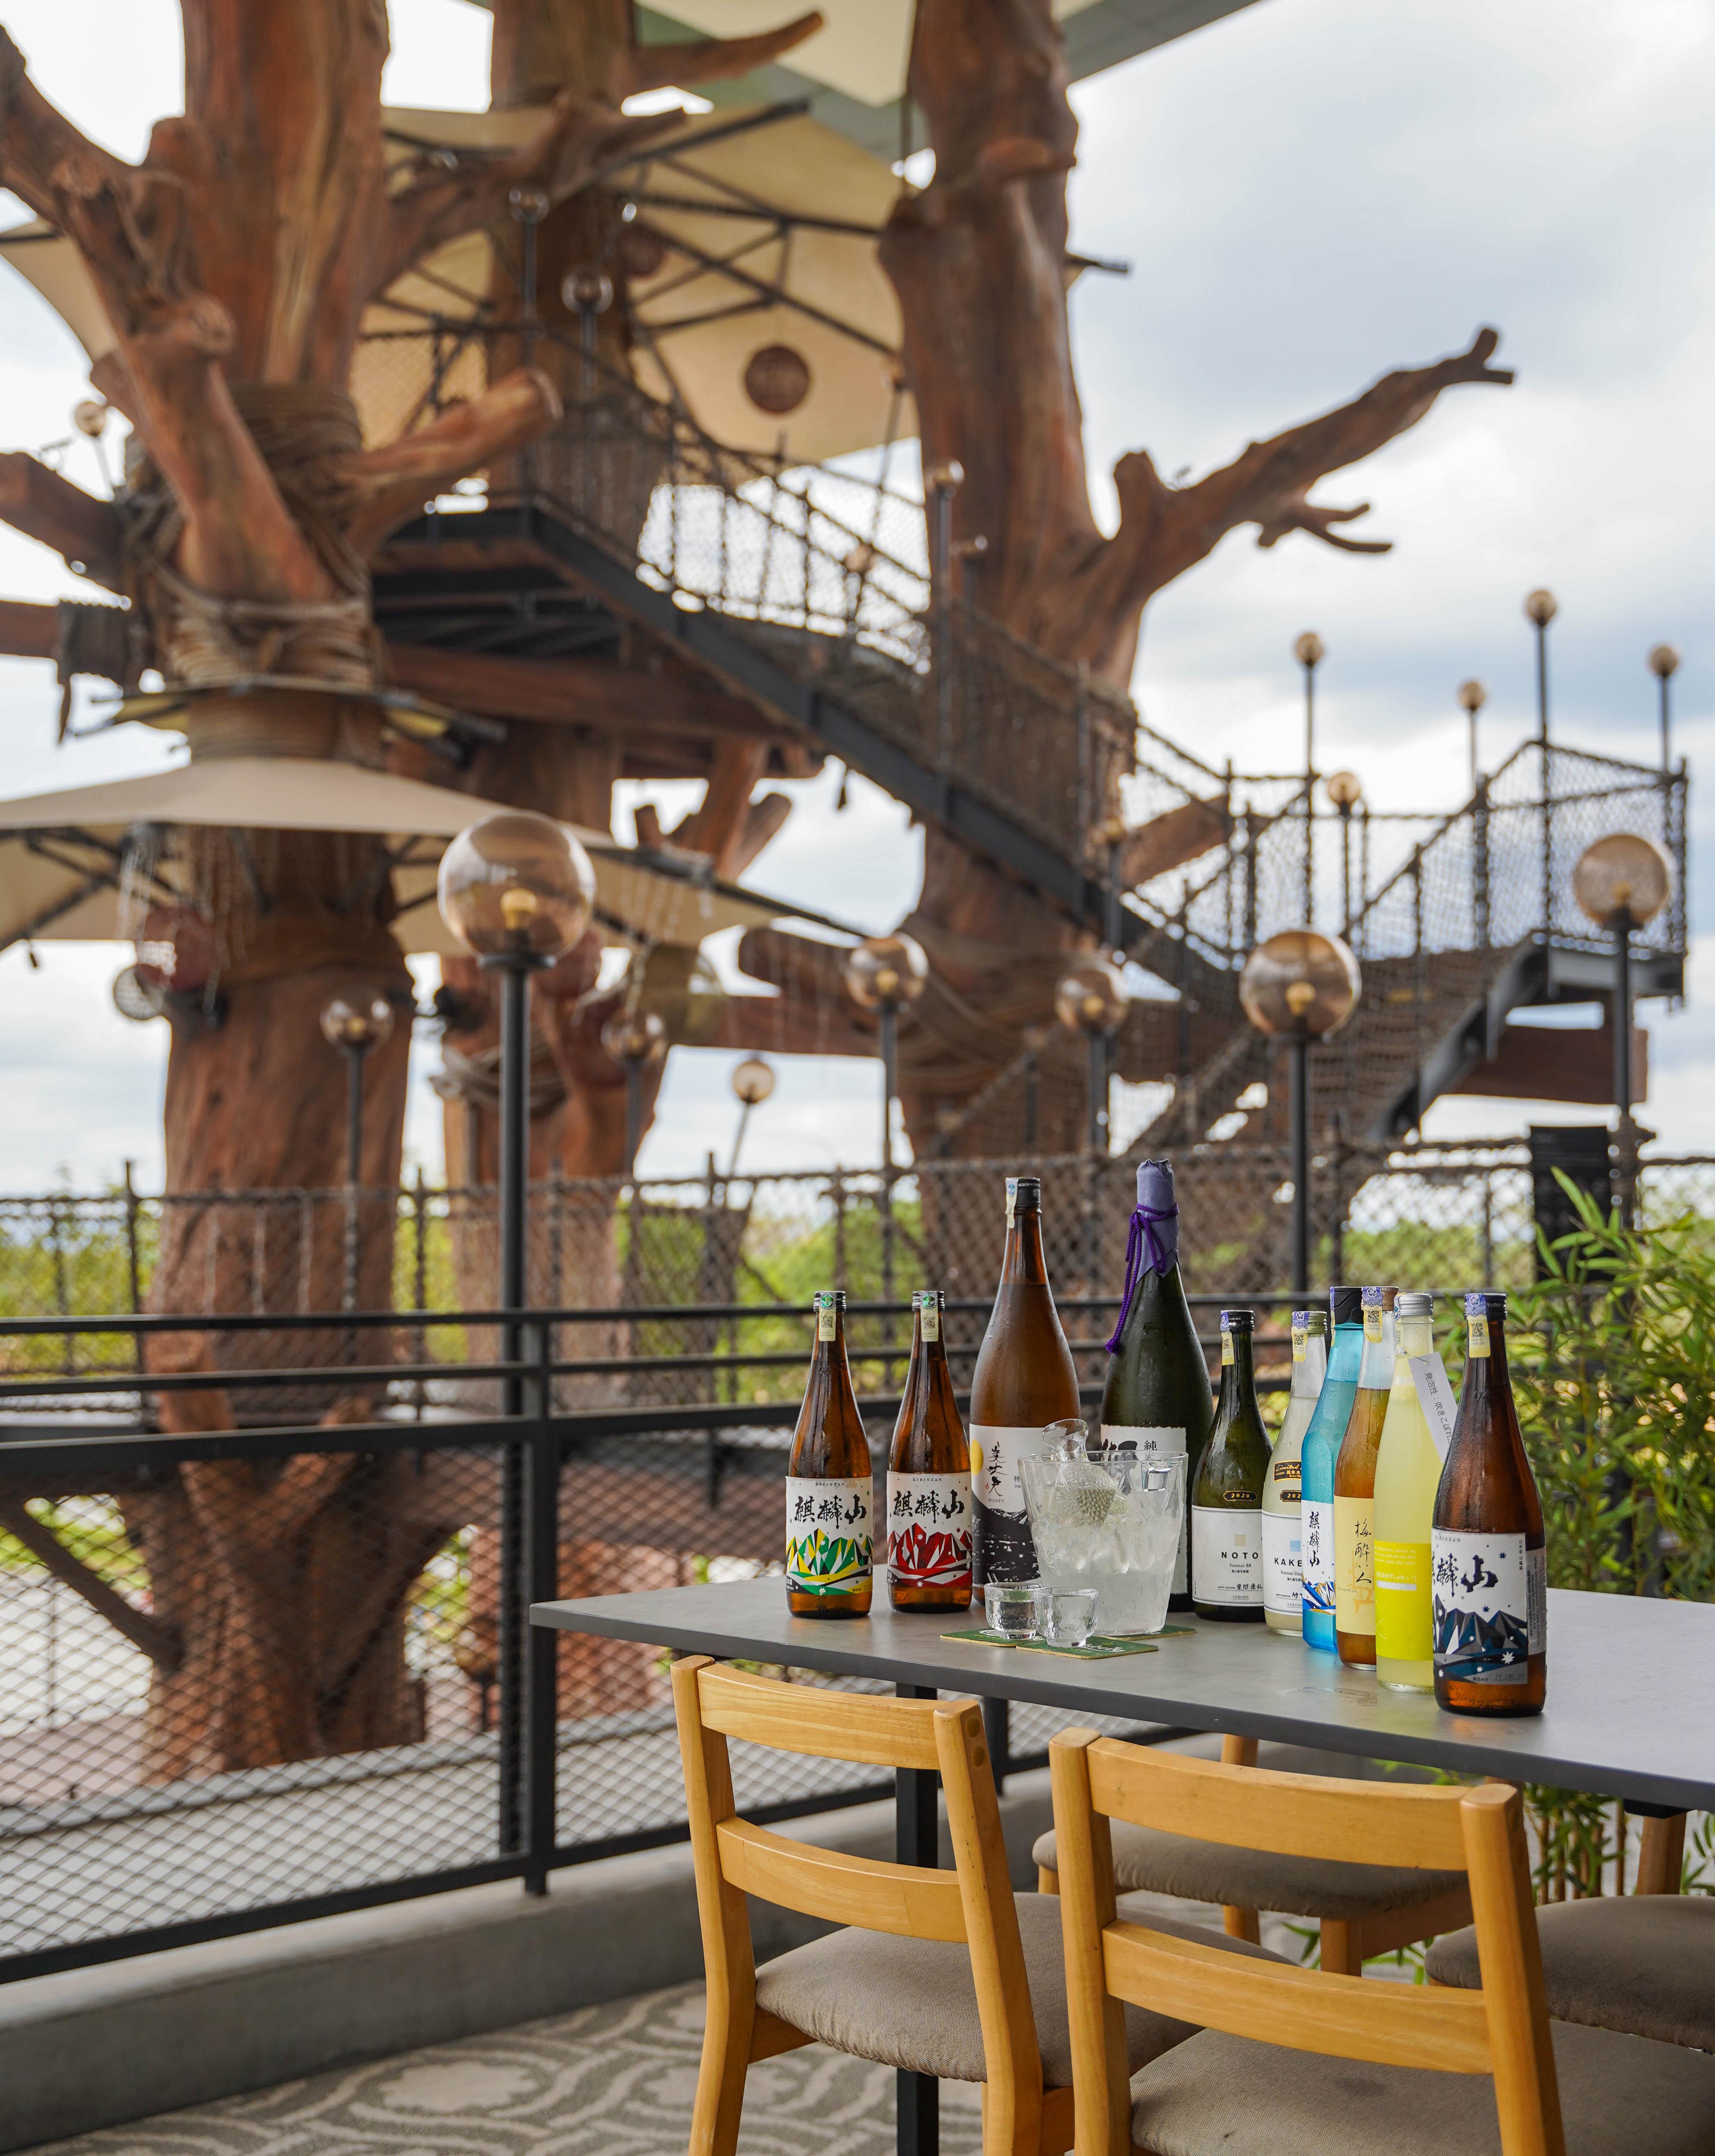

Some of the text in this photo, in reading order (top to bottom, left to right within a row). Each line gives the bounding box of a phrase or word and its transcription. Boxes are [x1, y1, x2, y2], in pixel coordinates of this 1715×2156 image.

[1144, 1440, 1157, 1450] 純
[794, 1494, 867, 1529] 麒麟山
[893, 1489, 965, 1524] 麒麟山
[1221, 1551, 1258, 1559] NOTO
[1309, 1511, 1320, 1567] 麒麟山
[1274, 1557, 1302, 1567] KAKE
[1432, 1551, 1498, 1597] 麟山
